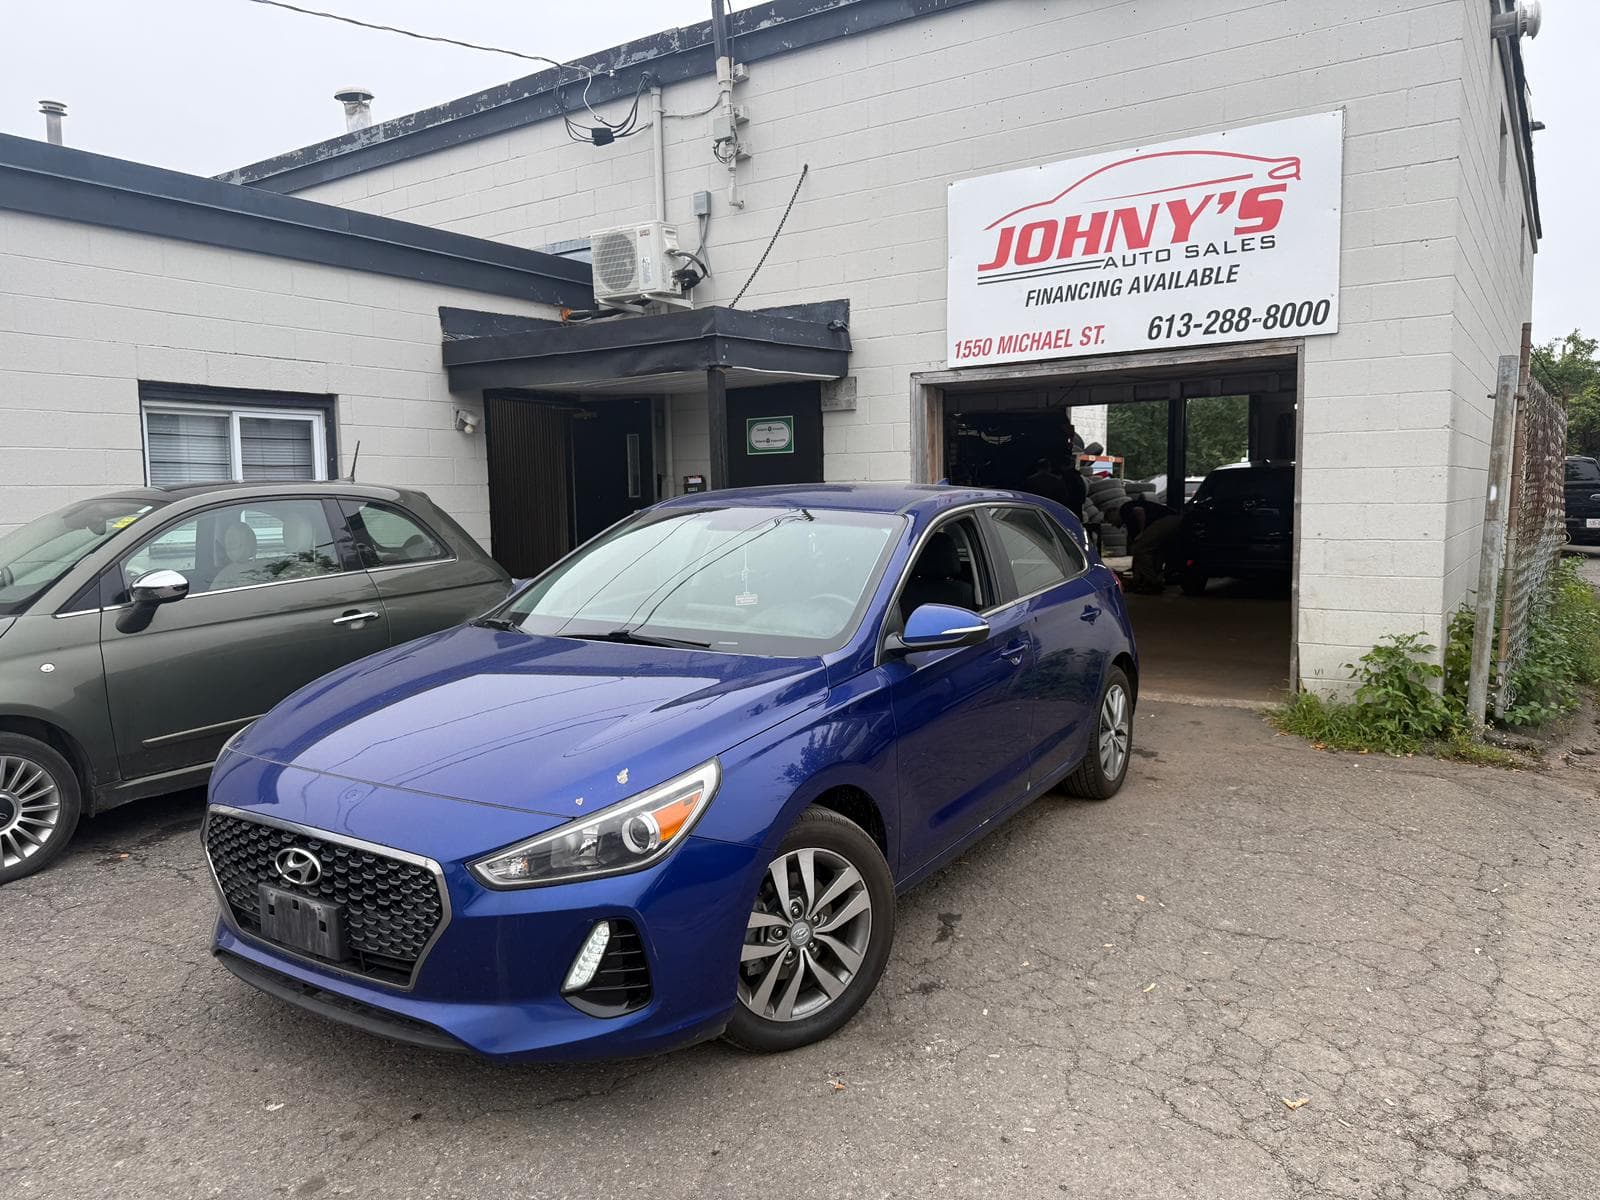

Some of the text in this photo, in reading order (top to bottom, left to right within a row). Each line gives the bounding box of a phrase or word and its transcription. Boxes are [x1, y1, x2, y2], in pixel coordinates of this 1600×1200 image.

[977, 183, 1288, 272] JOHNY'S
[1103, 234, 1276, 270] AUTO SALES
[1025, 264, 1241, 307] FINANCING AVAILABLE
[1147, 299, 1331, 341] 613-288-8000
[954, 324, 1106, 360] 1550 MICHAEL ST.
